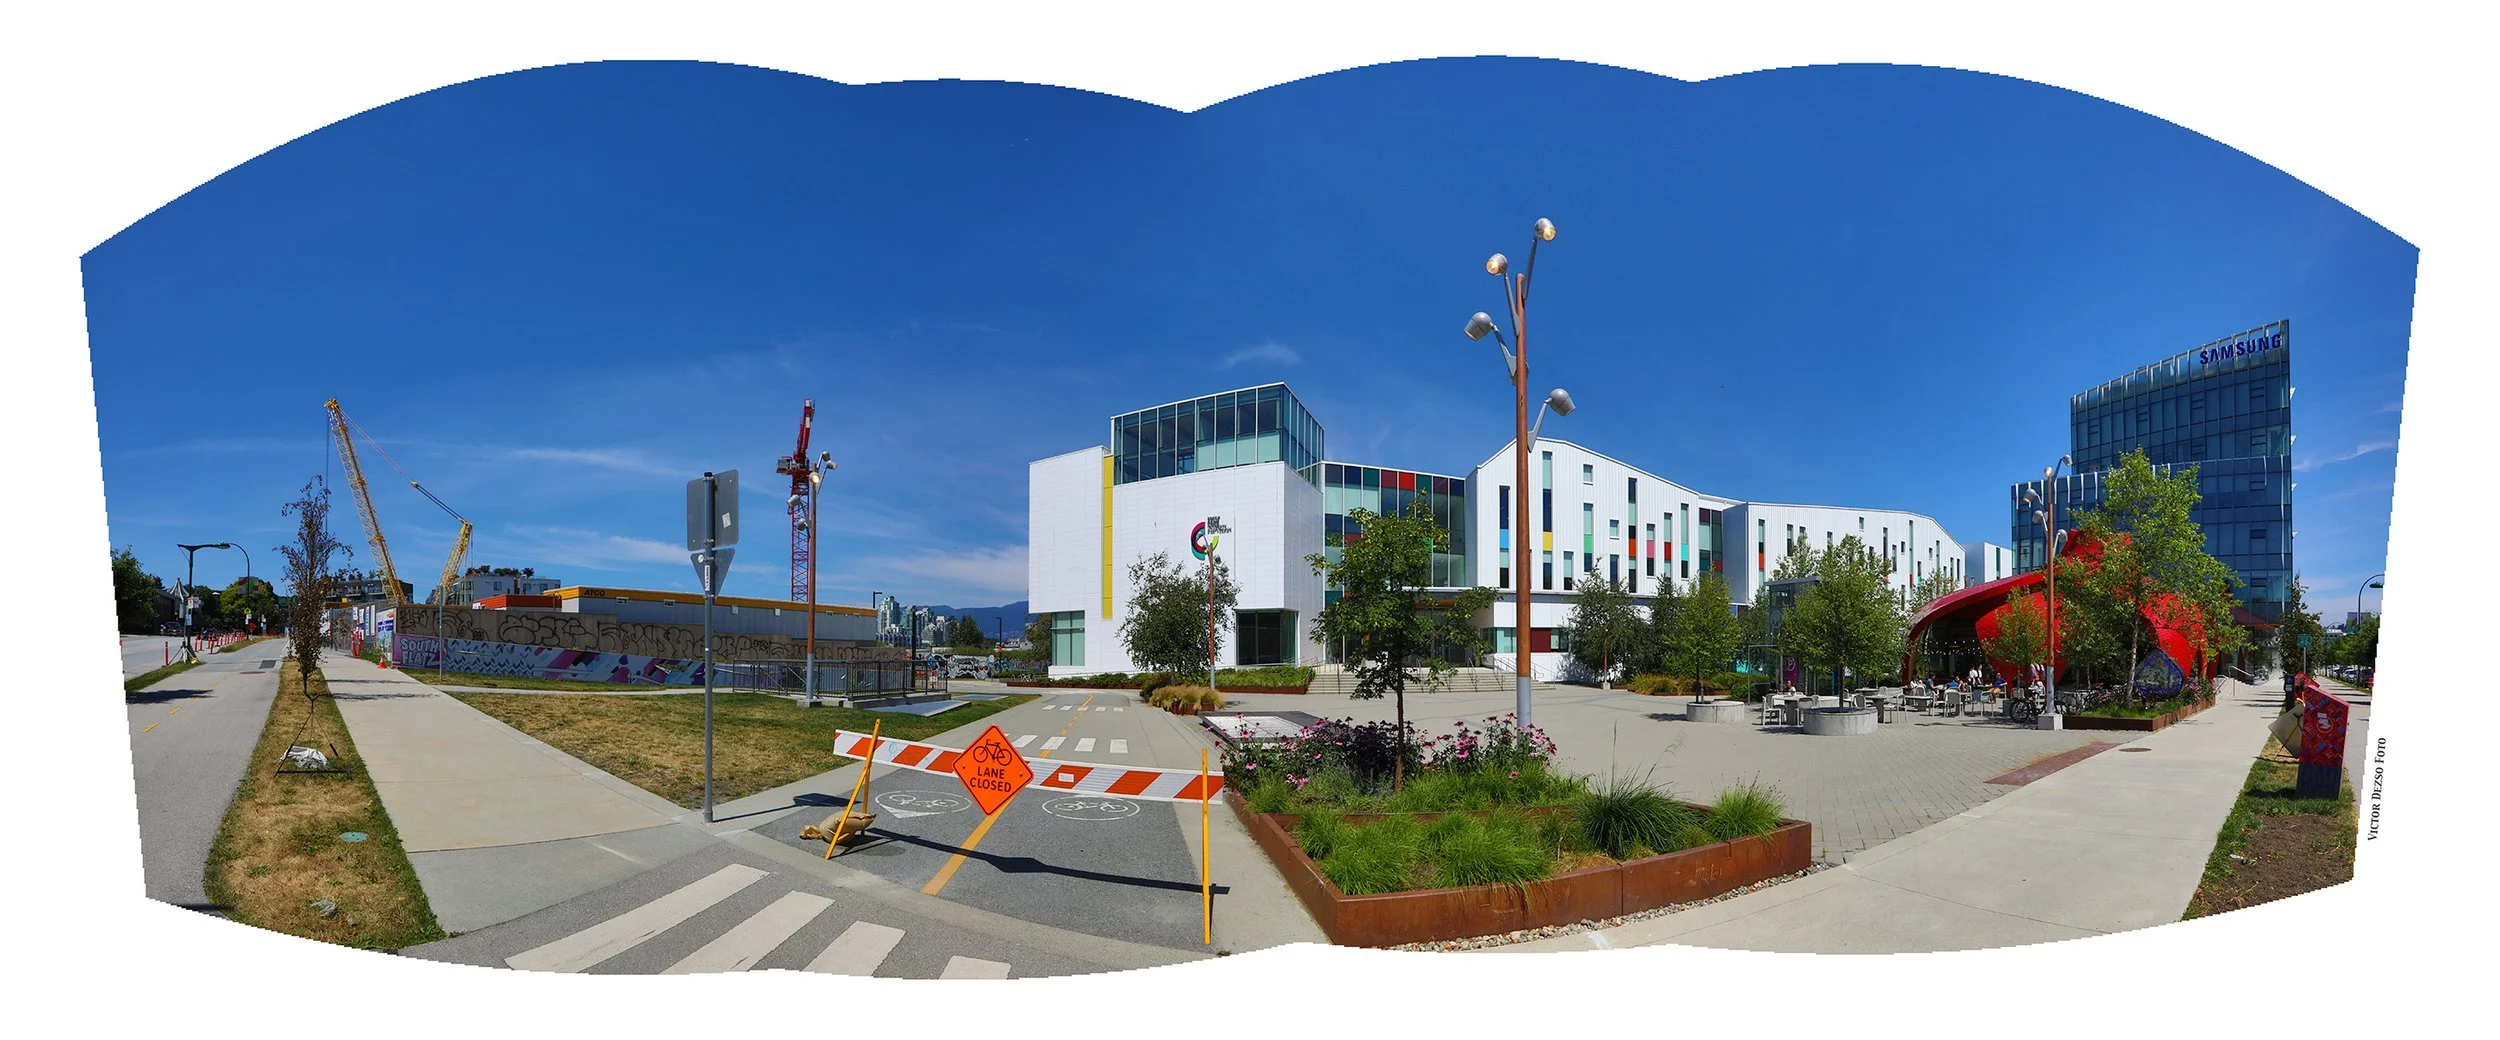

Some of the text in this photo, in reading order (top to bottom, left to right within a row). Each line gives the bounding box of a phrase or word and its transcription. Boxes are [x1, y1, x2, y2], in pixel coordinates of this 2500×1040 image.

[2199, 333, 2282, 365] SAMSUNG
[583, 589, 606, 597] ATCO
[400, 637, 439, 654] SOUTH
[977, 766, 1005, 780] LANE
[969, 777, 1012, 793] CLOSED
